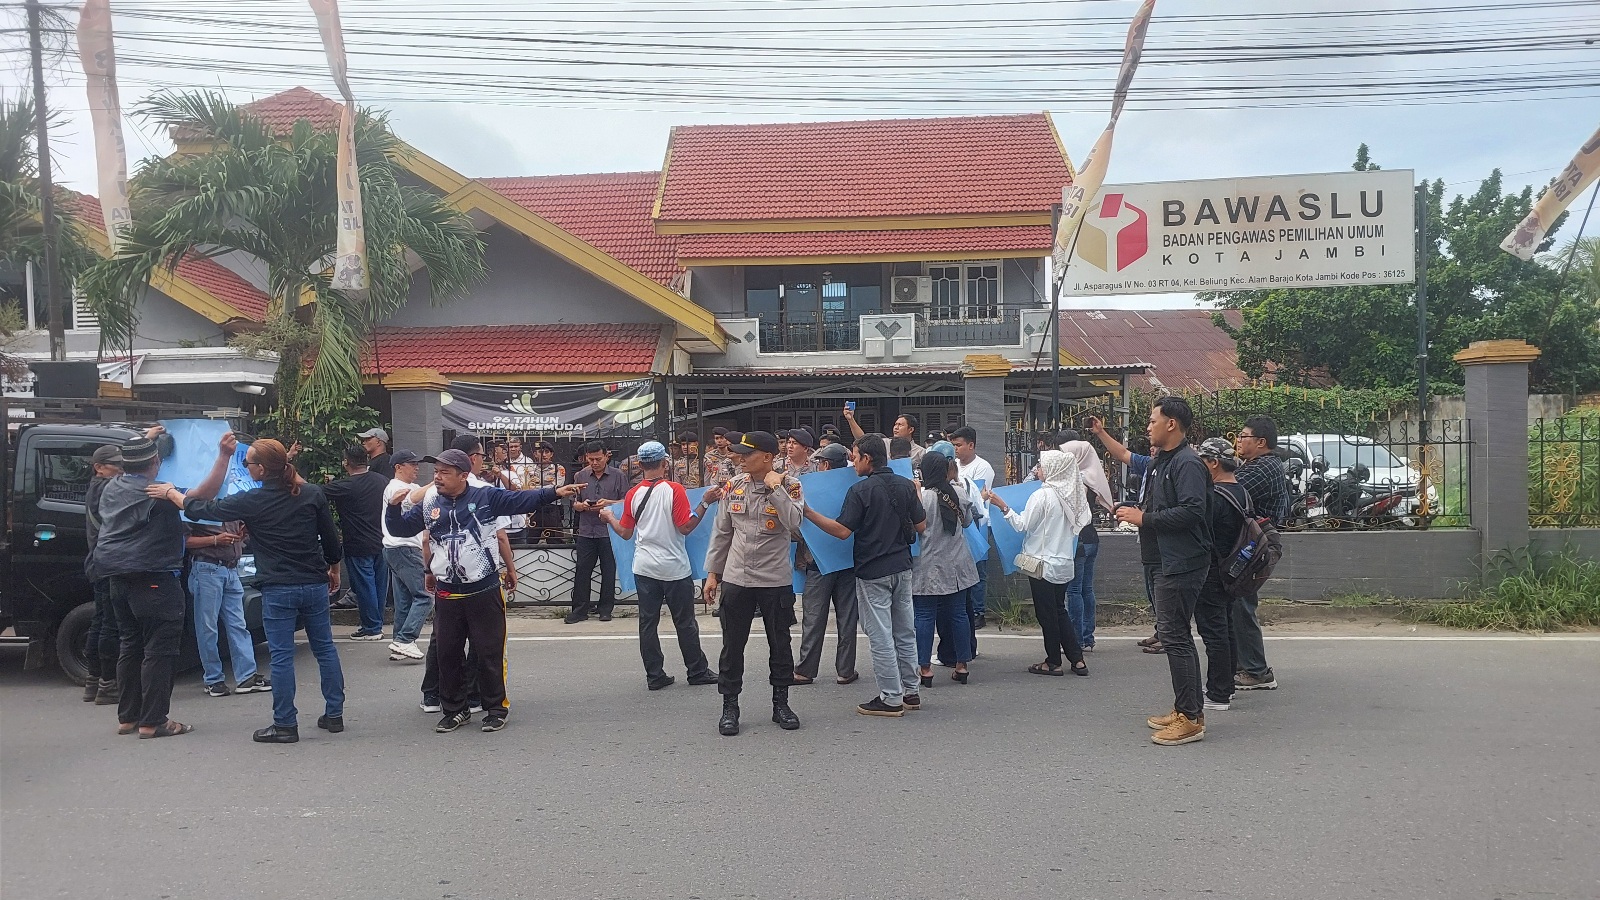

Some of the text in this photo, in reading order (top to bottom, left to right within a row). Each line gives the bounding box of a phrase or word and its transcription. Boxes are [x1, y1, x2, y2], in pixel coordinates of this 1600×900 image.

[1162, 190, 1384, 227] BAWASLU
[1163, 224, 1384, 248] BADAN PENGAWAS PEMILIHAN UMUM
[1162, 244, 1385, 266] KOTA JAMBI
[1073, 283, 1082, 291] Jl.
[1084, 282, 1122, 292] Asparagus
[1124, 281, 1132, 289] IV
[1134, 280, 1146, 288] No.
[1148, 280, 1157, 288] 03
[1158, 279, 1169, 287] RT
[1170, 279, 1182, 288] 04,
[1183, 278, 1198, 286] Kel.
[1200, 277, 1228, 287] Beliung
[1230, 276, 1247, 284] Kec.
[1248, 275, 1268, 284] Alam
[1269, 274, 1294, 284] Barajo
[1296, 273, 1314, 282] Kota
[1315, 272, 1338, 281] Jambi
[1340, 271, 1360, 280] Kode
[1362, 270, 1376, 279] Pos
[1383, 270, 1406, 279] 36125
[467, 422, 583, 431] SUMPAH PEMUDA
[514, 416, 560, 424] TAHUN
